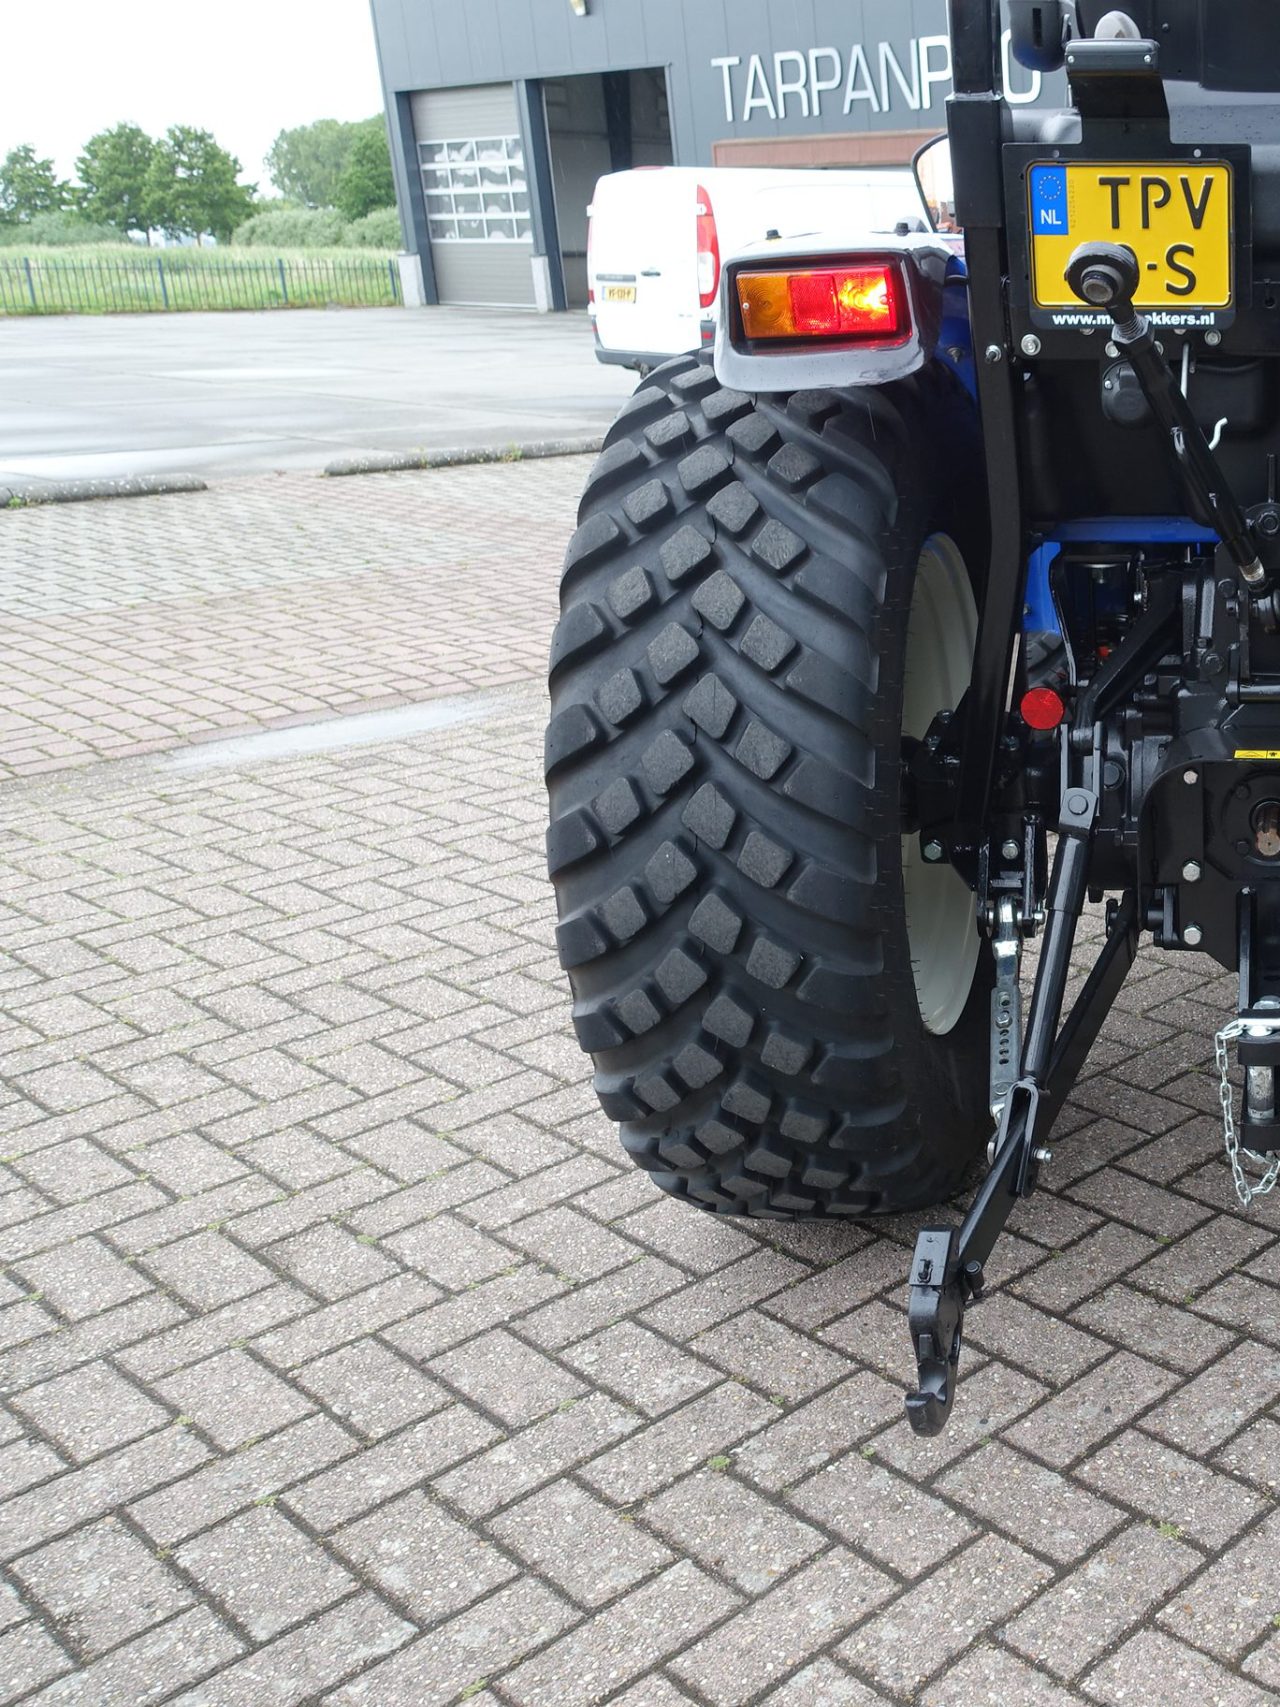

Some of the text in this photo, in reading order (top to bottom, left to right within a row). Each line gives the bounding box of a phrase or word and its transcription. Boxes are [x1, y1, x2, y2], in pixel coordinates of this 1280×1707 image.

[710, 28, 1042, 122] TARPANPO
[1040, 208, 1062, 225] NL
[1098, 175, 1215, 230] TPV
